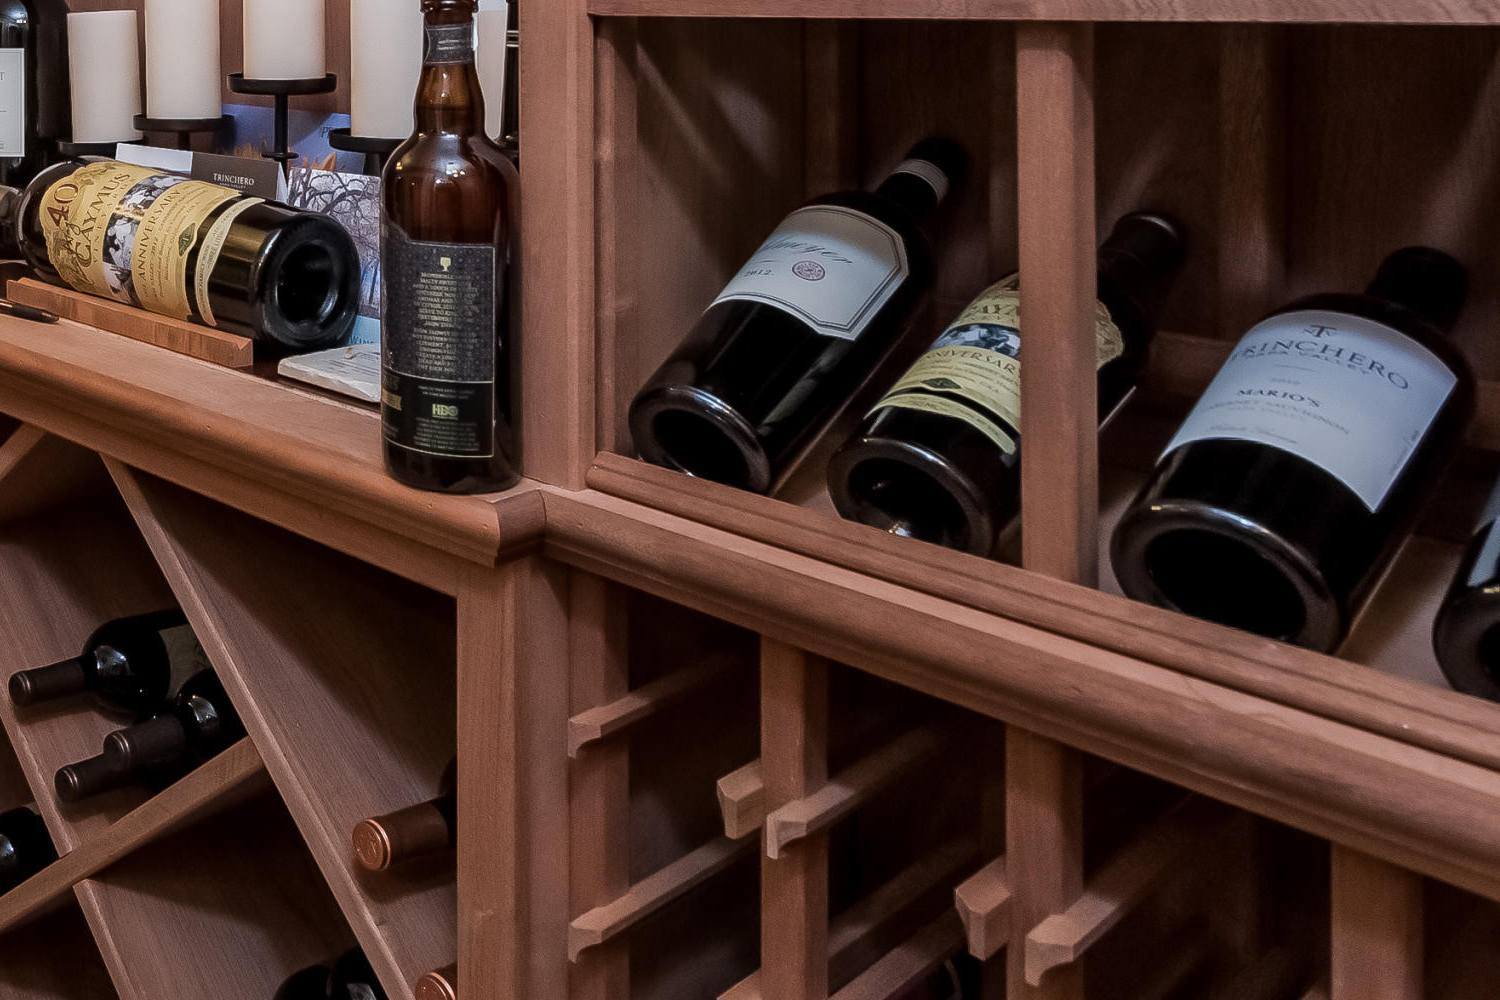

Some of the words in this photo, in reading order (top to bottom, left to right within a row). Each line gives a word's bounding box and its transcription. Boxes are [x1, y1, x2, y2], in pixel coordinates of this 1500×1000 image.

[212, 172, 255, 187] TRINCHERO
[46, 183, 80, 228] 40
[68, 172, 132, 269] CAYMUS
[139, 189, 181, 282] ANNIVERSARY
[431, 403, 460, 418] HBO
